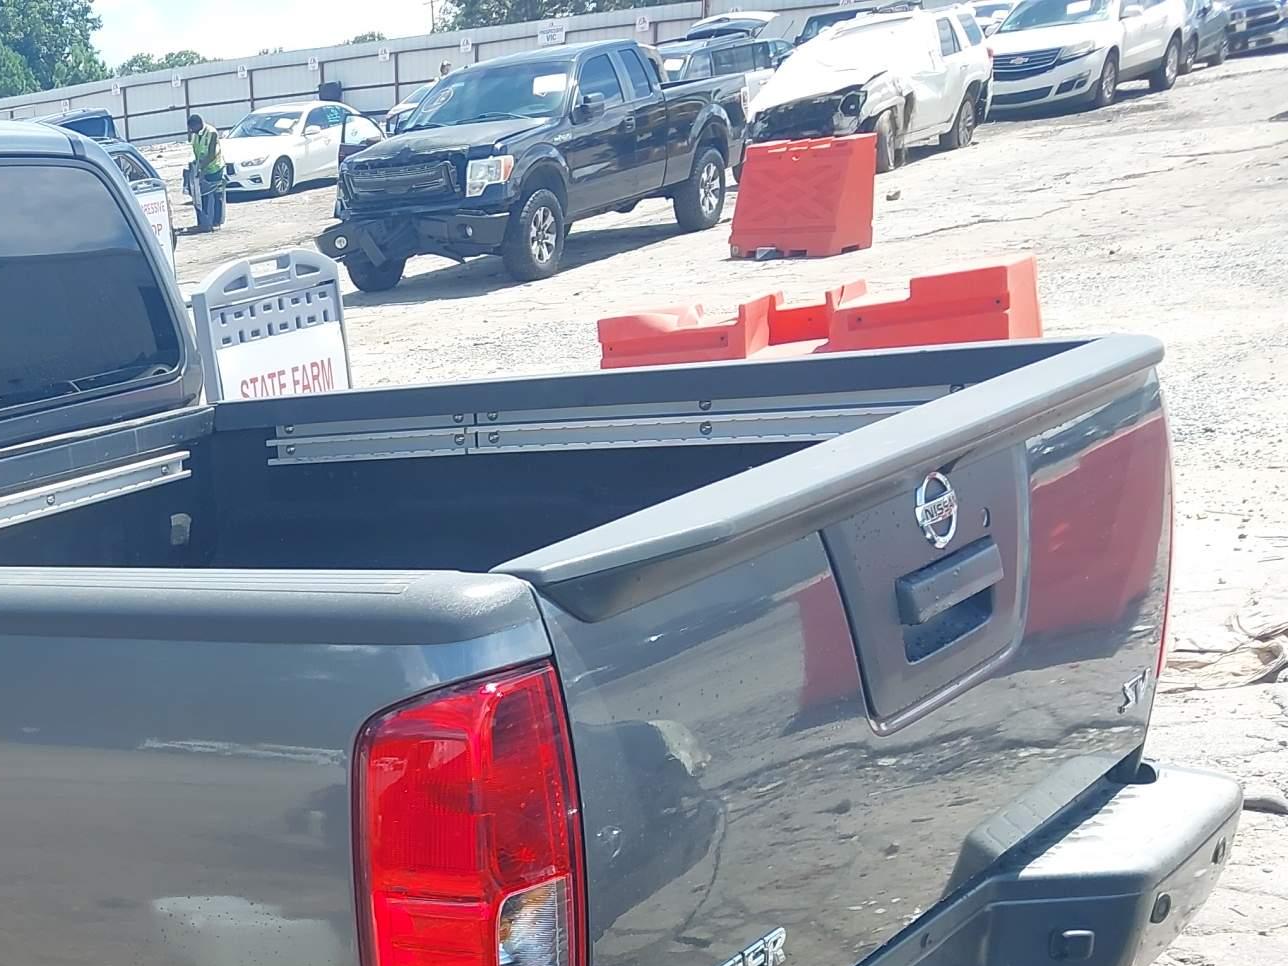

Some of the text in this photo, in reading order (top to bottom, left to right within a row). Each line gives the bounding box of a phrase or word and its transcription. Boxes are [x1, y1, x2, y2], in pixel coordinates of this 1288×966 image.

[546, 33, 557, 42] VIC
[240, 357, 335, 399] STATE FARM
